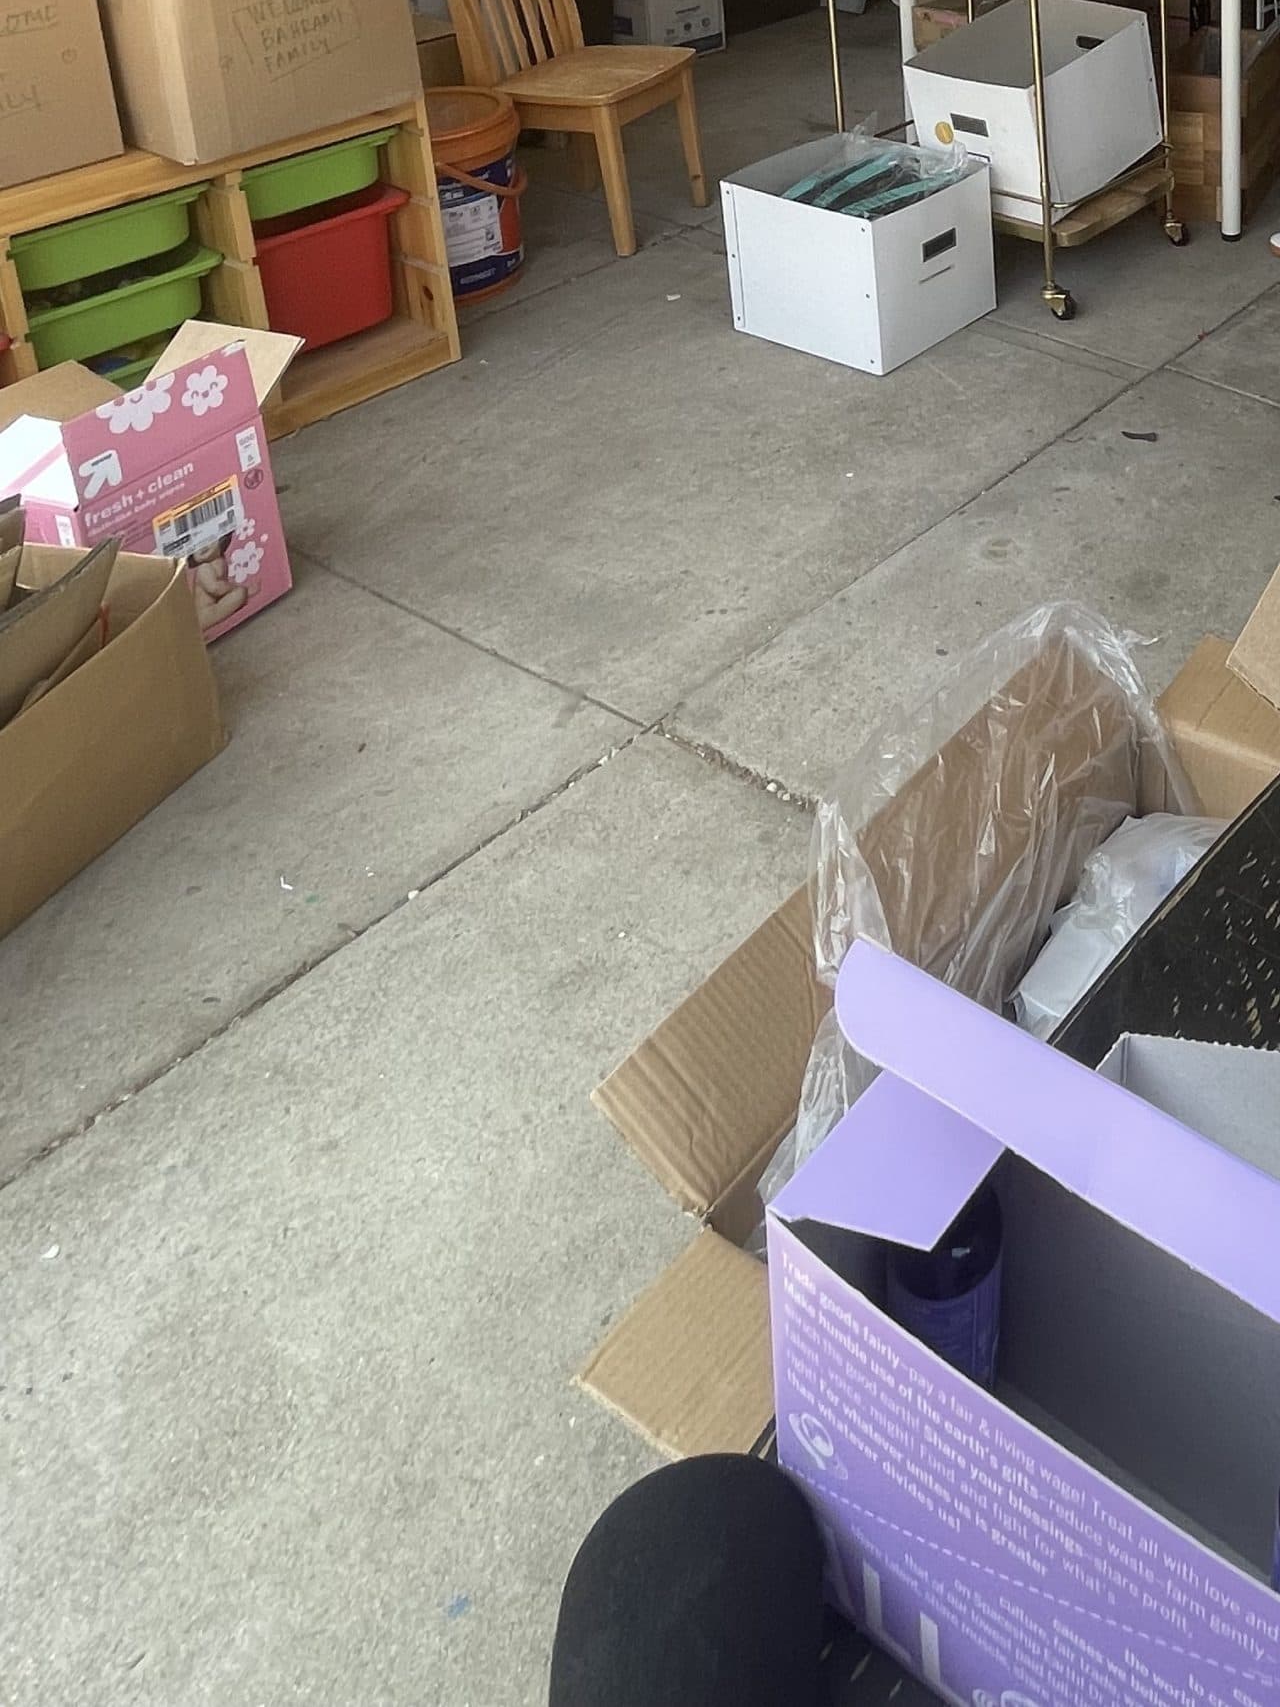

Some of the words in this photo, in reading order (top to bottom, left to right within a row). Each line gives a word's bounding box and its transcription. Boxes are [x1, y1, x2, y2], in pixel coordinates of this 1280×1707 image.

[264, 36, 332, 74] FAMILY
[84, 494, 133, 527] fresh
[147, 462, 194, 494] clean
[783, 1275, 815, 1320] Make
[818, 1308, 866, 1365] humble
[870, 1357, 895, 1390] use
[898, 1379, 912, 1404] of
[916, 1393, 940, 1426] the
[944, 1416, 997, 1472] earth's
[783, 1251, 815, 1296] Trade
[819, 1288, 859, 1335] goods
[938, 1388, 945, 1405] a
[951, 1394, 972, 1427] fair
[979, 1414, 989, 1439] &
[996, 1429, 1035, 1472] living
[1040, 1466, 1085, 1503] wage!
[1092, 1499, 1133, 1541] Treat
[1139, 1533, 1160, 1559] all
[1163, 1550, 1199, 1586] with
[1205, 1577, 1241, 1616] love
[1246, 1610, 1279, 1641] and
[787, 1366, 814, 1406] than
[817, 1399, 878, 1465] whatever
[882, 1456, 933, 1512] divides
[819, 1376, 838, 1409] For
[842, 1399, 901, 1464] whatever
[906, 1456, 950, 1504] unites
[954, 1496, 970, 1521] us
[976, 1512, 987, 1532] is
[992, 1529, 1047, 1576] greater
[923, 1422, 965, 1470] Share
[970, 1464, 1002, 1495] your
[1125, 1647, 1149, 1677] the
